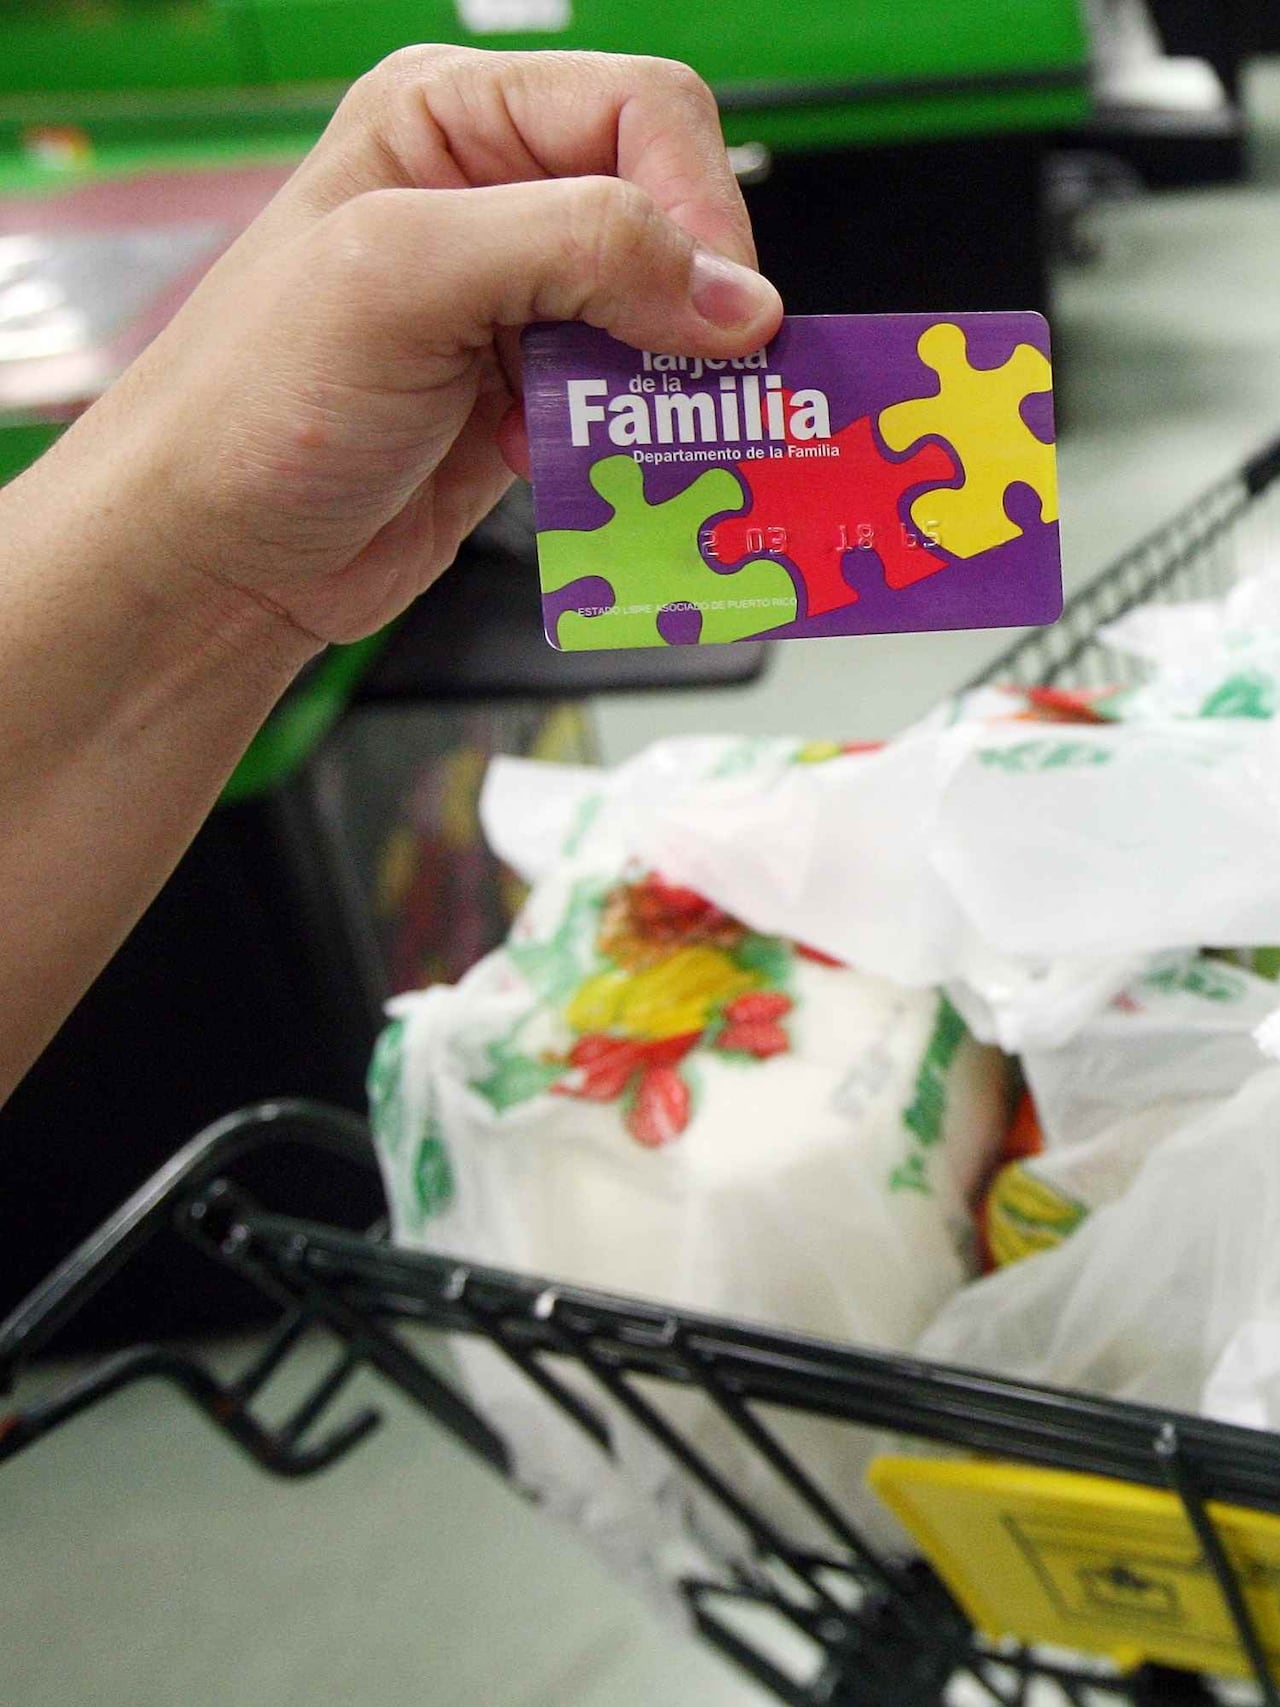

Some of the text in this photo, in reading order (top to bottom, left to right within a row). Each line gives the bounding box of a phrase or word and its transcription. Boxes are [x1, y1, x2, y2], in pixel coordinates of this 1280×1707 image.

[629, 373, 682, 393] de la
[567, 375, 831, 446] Familia
[633, 444, 840, 465] Departamento de la Familia
[577, 605, 620, 617] ESTADO
